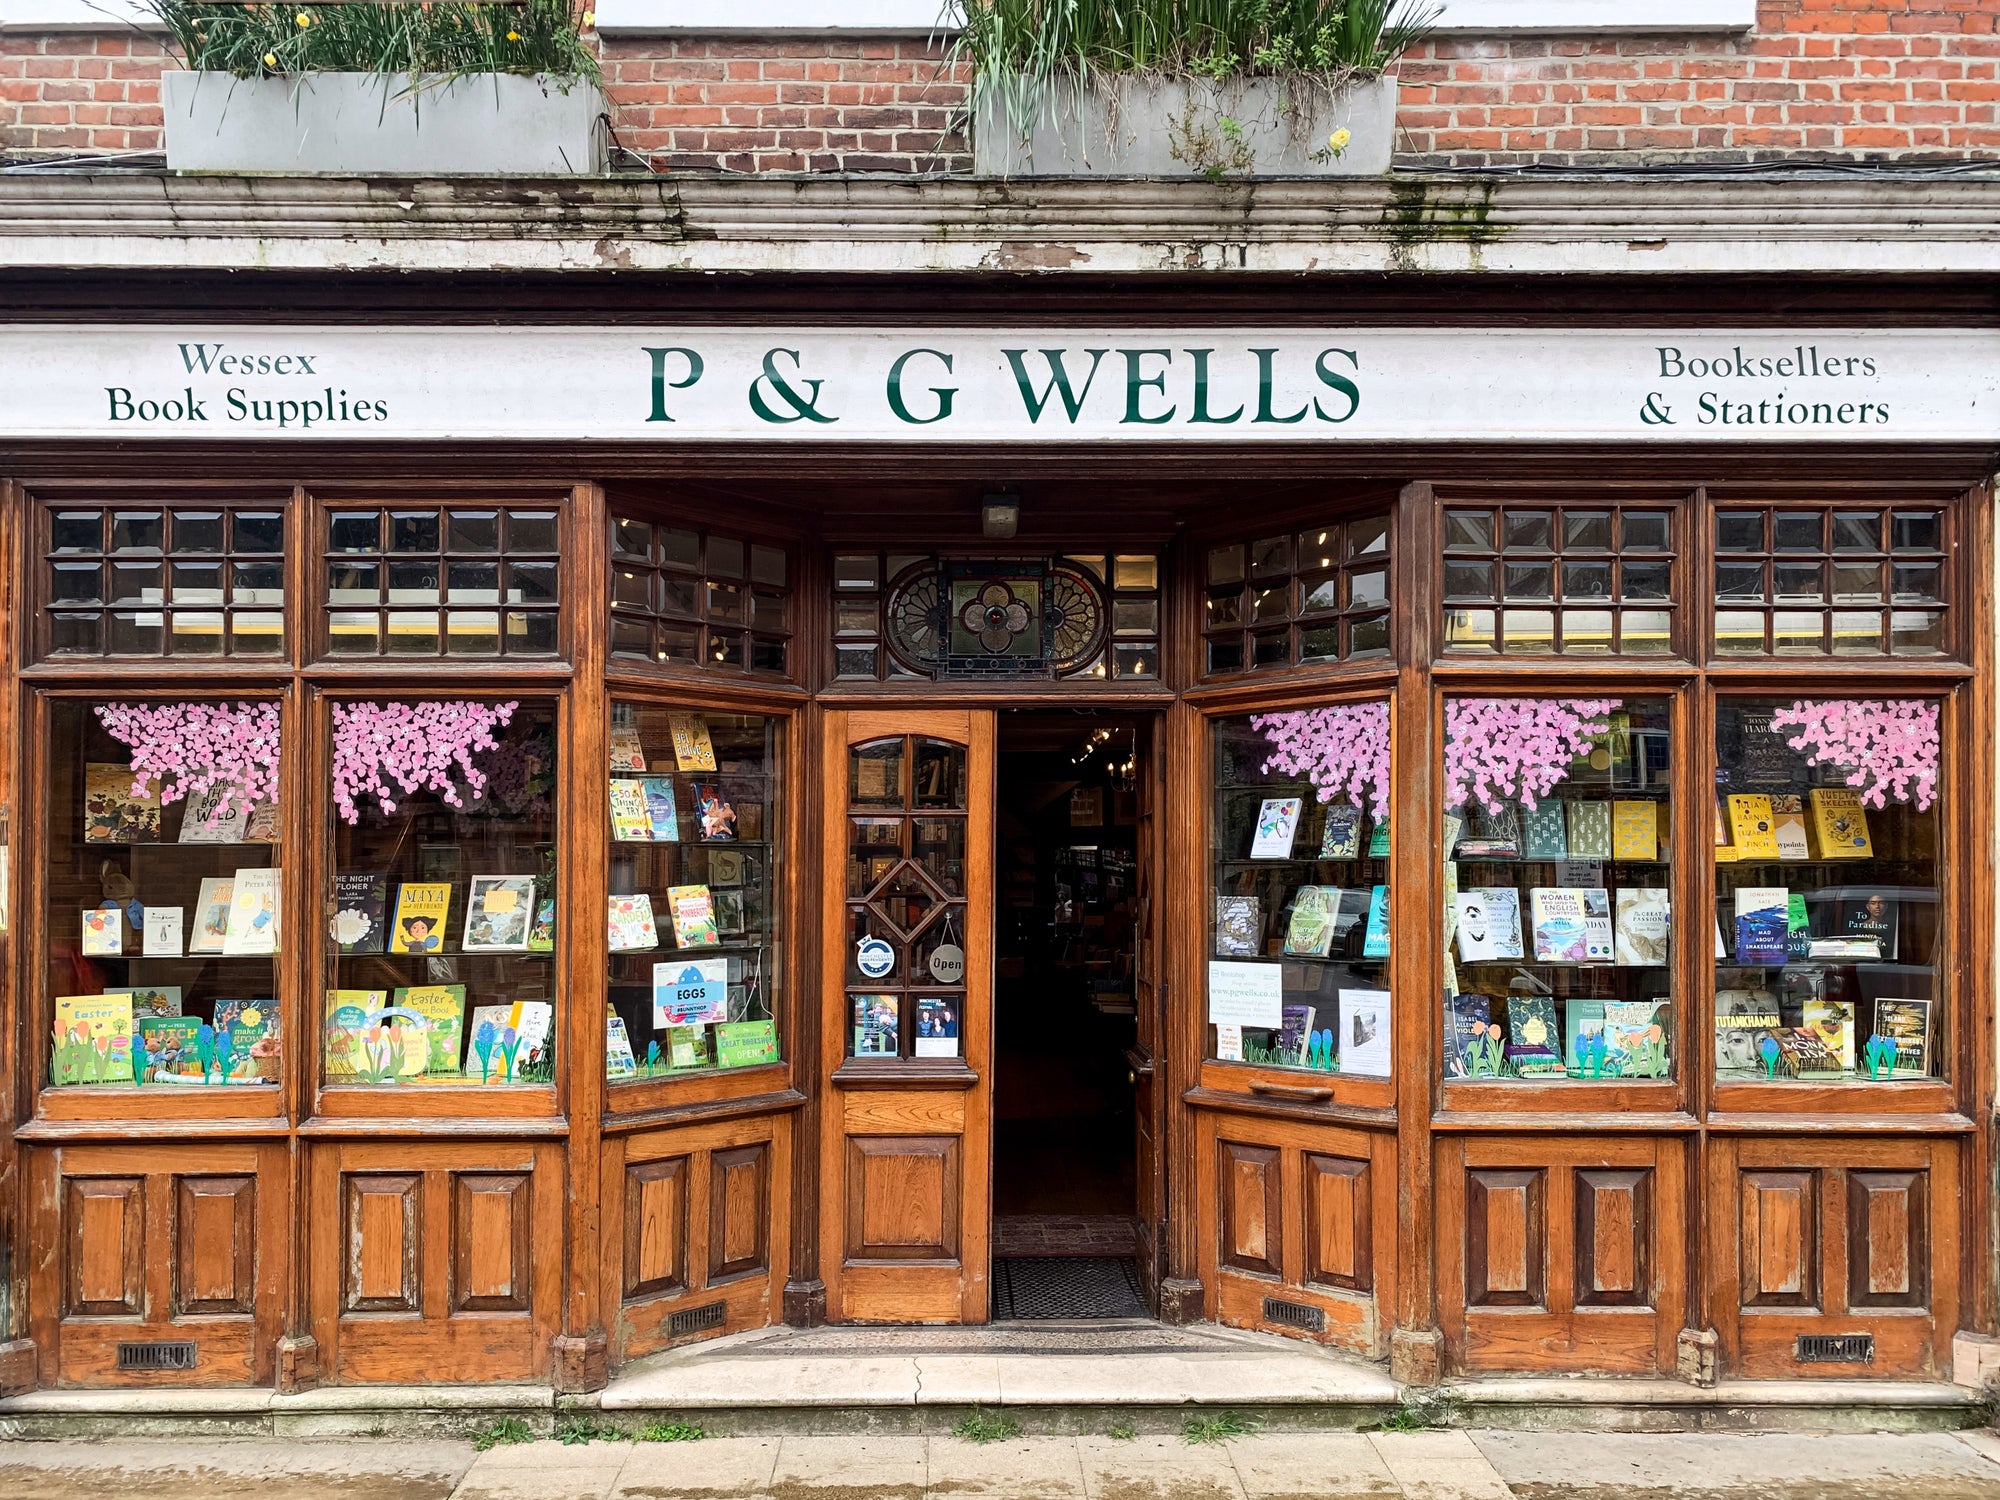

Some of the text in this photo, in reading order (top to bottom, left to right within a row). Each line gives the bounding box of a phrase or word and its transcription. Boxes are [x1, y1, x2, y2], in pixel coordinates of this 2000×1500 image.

[178, 344, 316, 375] Wessex
[1656, 345, 1876, 378] Booksellers
[641, 346, 1360, 425] P & G WELLS
[104, 386, 388, 428] Book Supplies
[1640, 391, 1889, 425] & Stationers
[678, 744, 702, 755] active
[1819, 791, 1858, 800] VUELTA
[1737, 802, 1766, 810] JULIAN
[196, 807, 237, 823] WLD
[331, 875, 375, 883] THE NIGHT
[404, 889, 444, 903] MAYA
[1855, 911, 1868, 920] To
[1848, 920, 1889, 930] Paradise
[1787, 931, 1807, 939] IGH
[934, 958, 961, 970] Open
[677, 987, 706, 1000] EGGS
[411, 993, 446, 1006] Easter
[74, 1009, 113, 1019] Easter
[1715, 1015, 1781, 1028] TUTANKHAMUN
[144, 1028, 198, 1040] HATCH
[234, 1027, 264, 1035] make it
[1783, 1041, 1825, 1050] MONA
[1797, 1050, 1827, 1059] LISA
[1896, 1047, 1921, 1056] PTIVES
